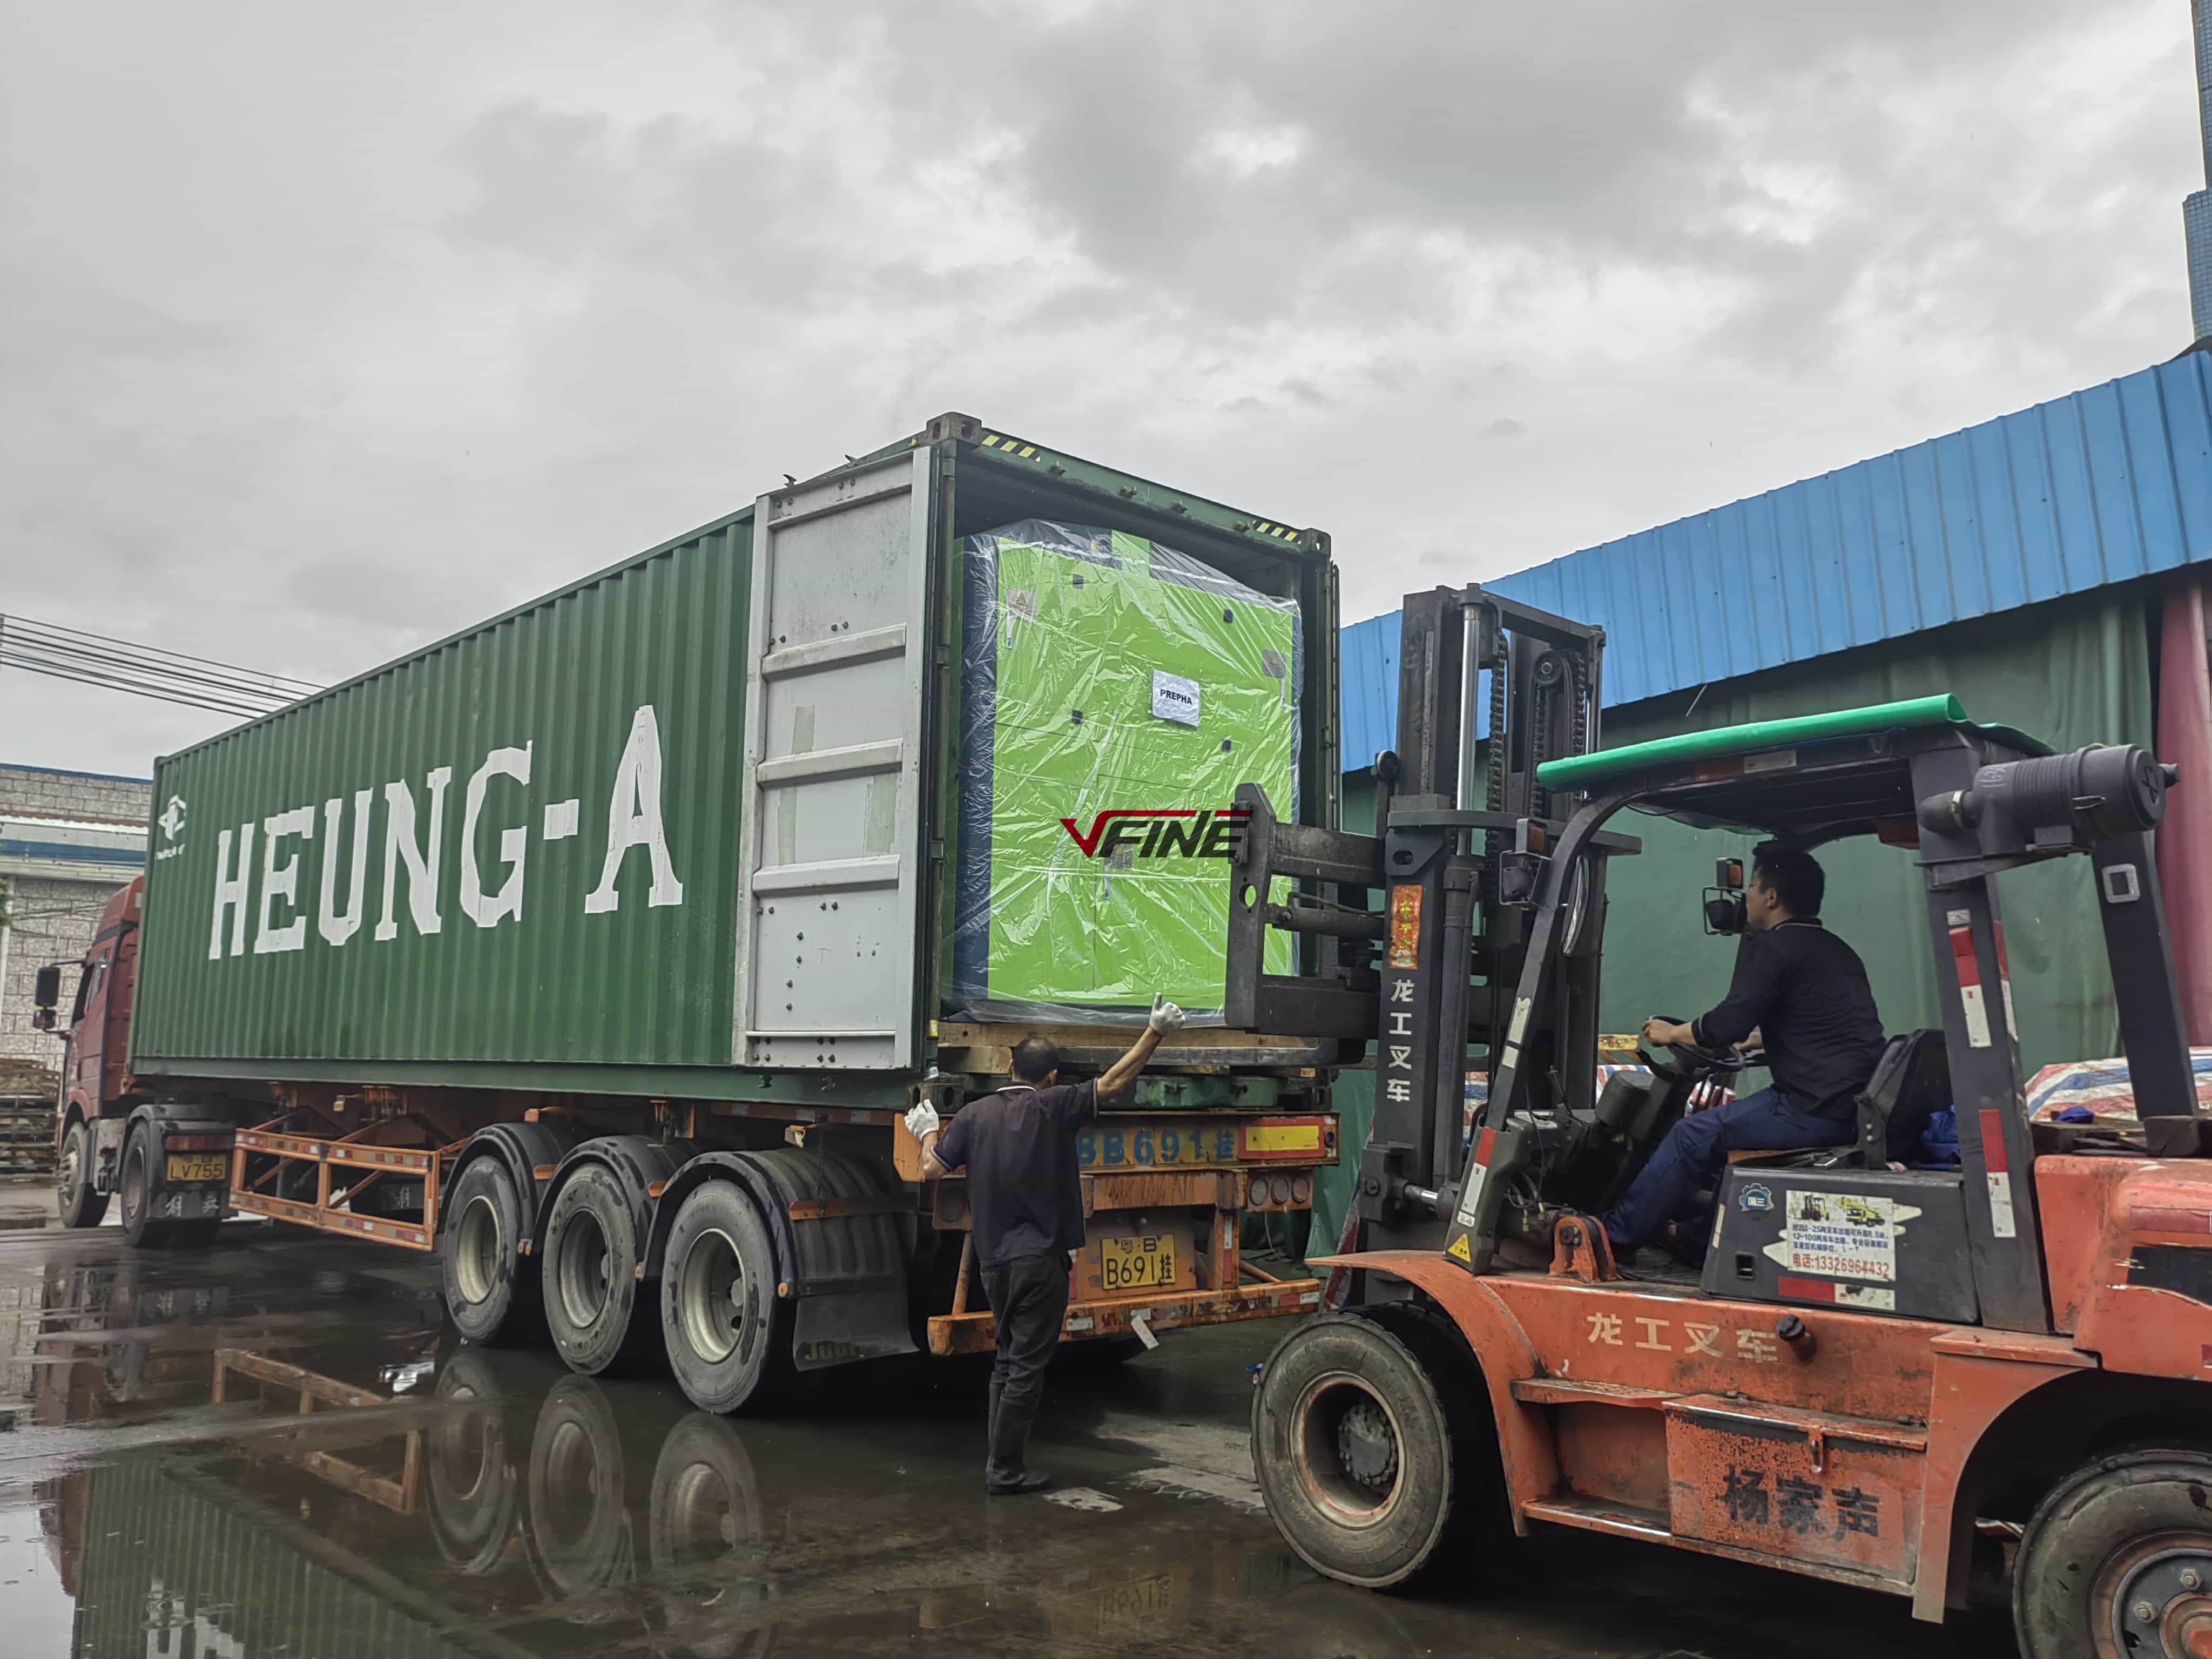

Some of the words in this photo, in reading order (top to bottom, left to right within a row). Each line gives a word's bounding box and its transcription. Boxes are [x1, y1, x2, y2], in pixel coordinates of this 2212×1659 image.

[1159, 689, 1193, 705] PREPHA
[209, 705, 683, 960] HEUNG-A
[1386, 979, 1415, 1102] 龙工叉车
[170, 1163, 223, 1179] LV755
[1106, 1253, 1172, 1285] B691挂
[1587, 1312, 1778, 1364] 龙工叉车
[1717, 1464, 1881, 1542] 杨家声
